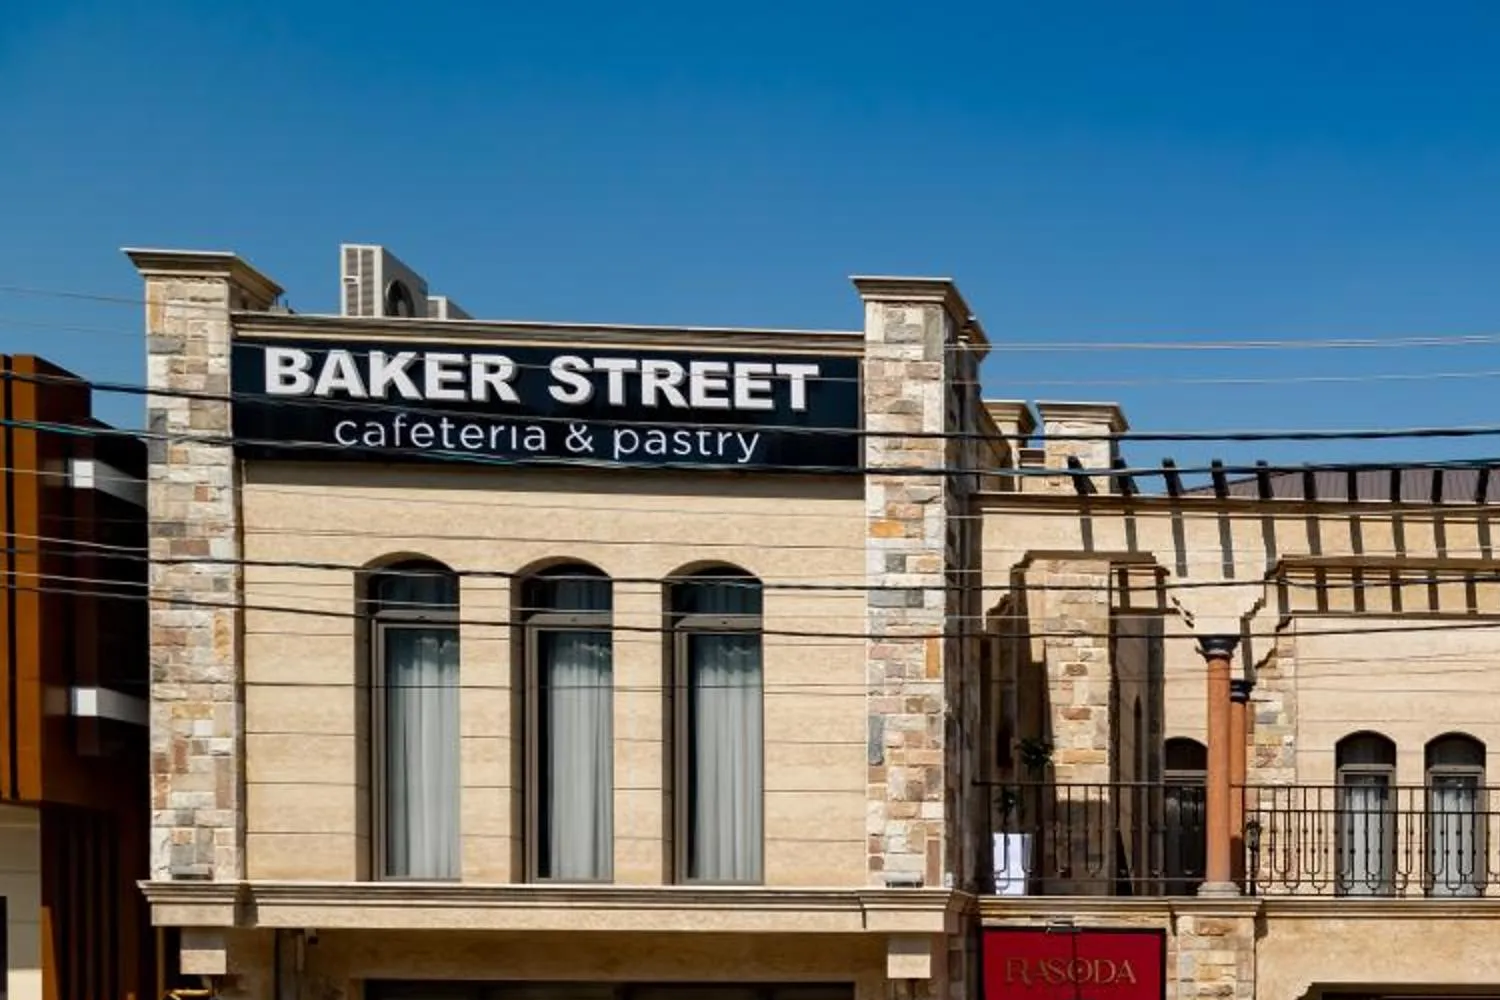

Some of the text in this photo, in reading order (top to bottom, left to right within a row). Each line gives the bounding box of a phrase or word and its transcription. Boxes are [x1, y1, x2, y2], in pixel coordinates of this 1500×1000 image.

[263, 346, 820, 412] BAKER STREET
[334, 413, 761, 464] cafeteria & pastry
[1006, 957, 1137, 985] RASODA
